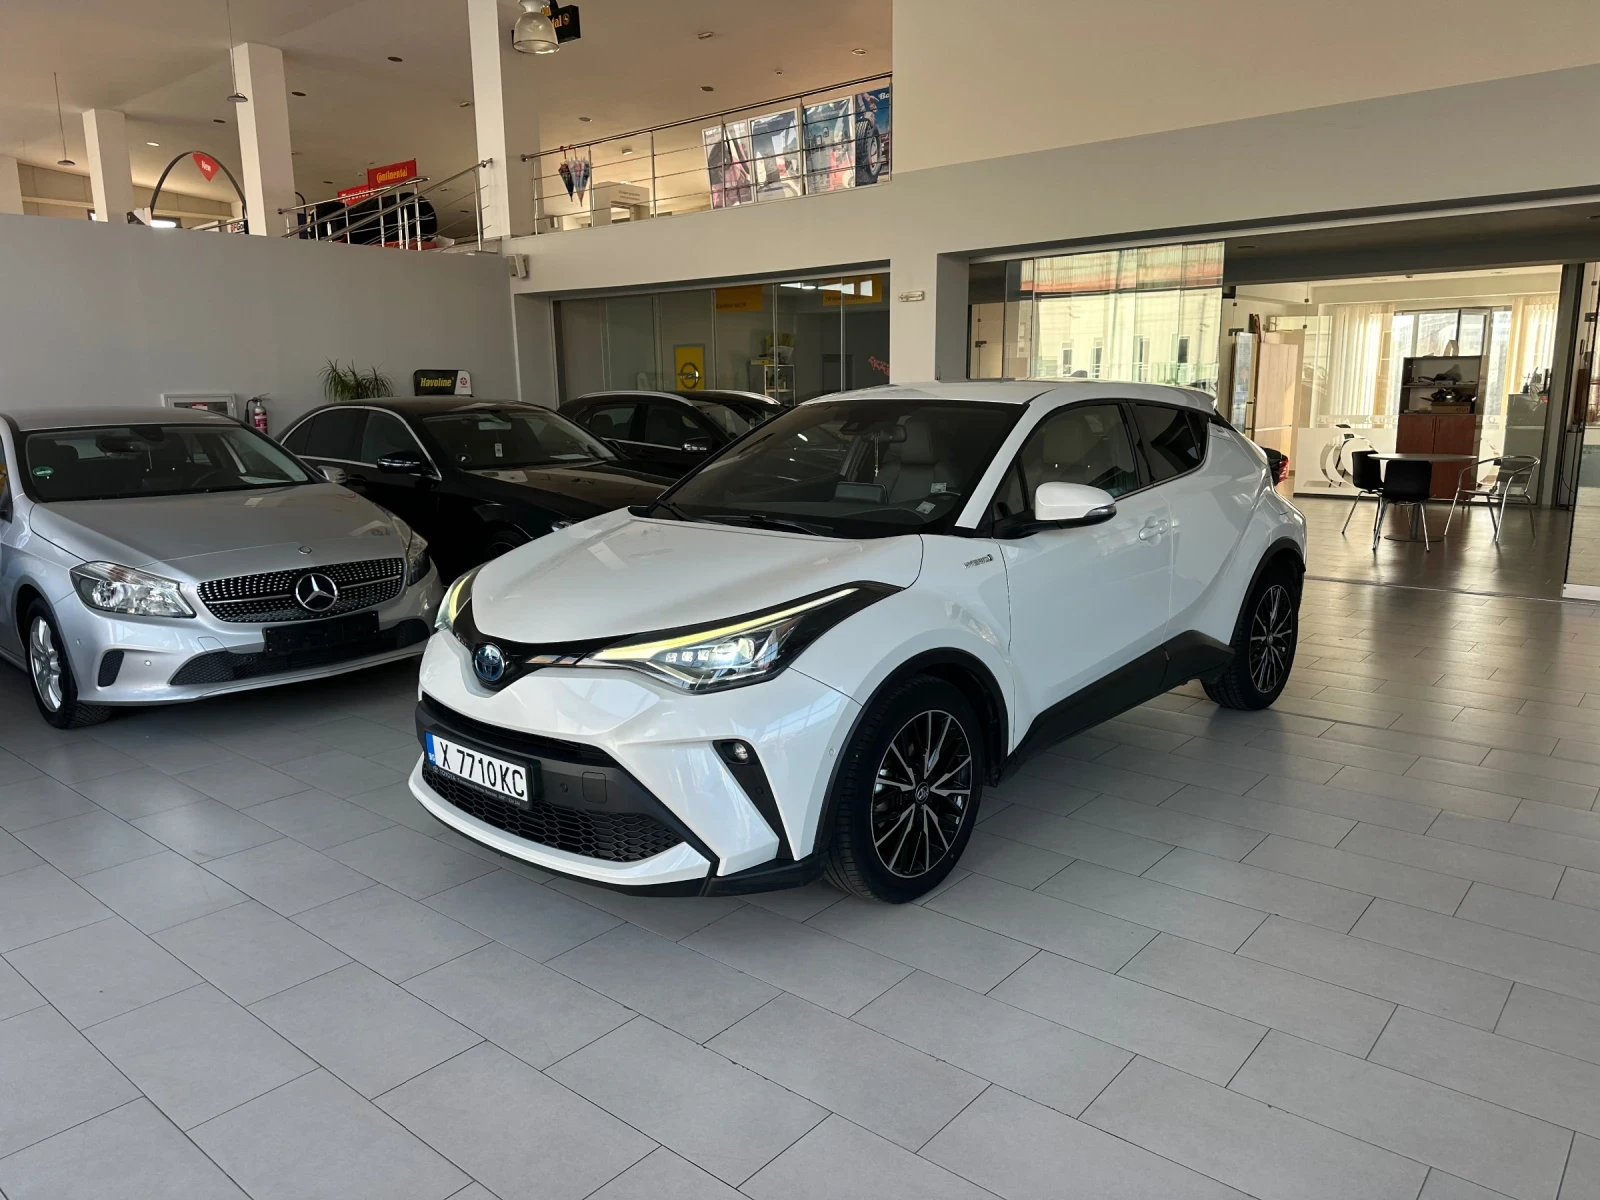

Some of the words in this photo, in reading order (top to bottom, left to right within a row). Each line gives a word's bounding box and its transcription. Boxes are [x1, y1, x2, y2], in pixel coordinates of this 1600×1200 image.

[201, 160, 212, 172] New
[376, 166, 408, 184] Continental
[420, 377, 452, 387] Havoline
[440, 741, 451, 770] X
